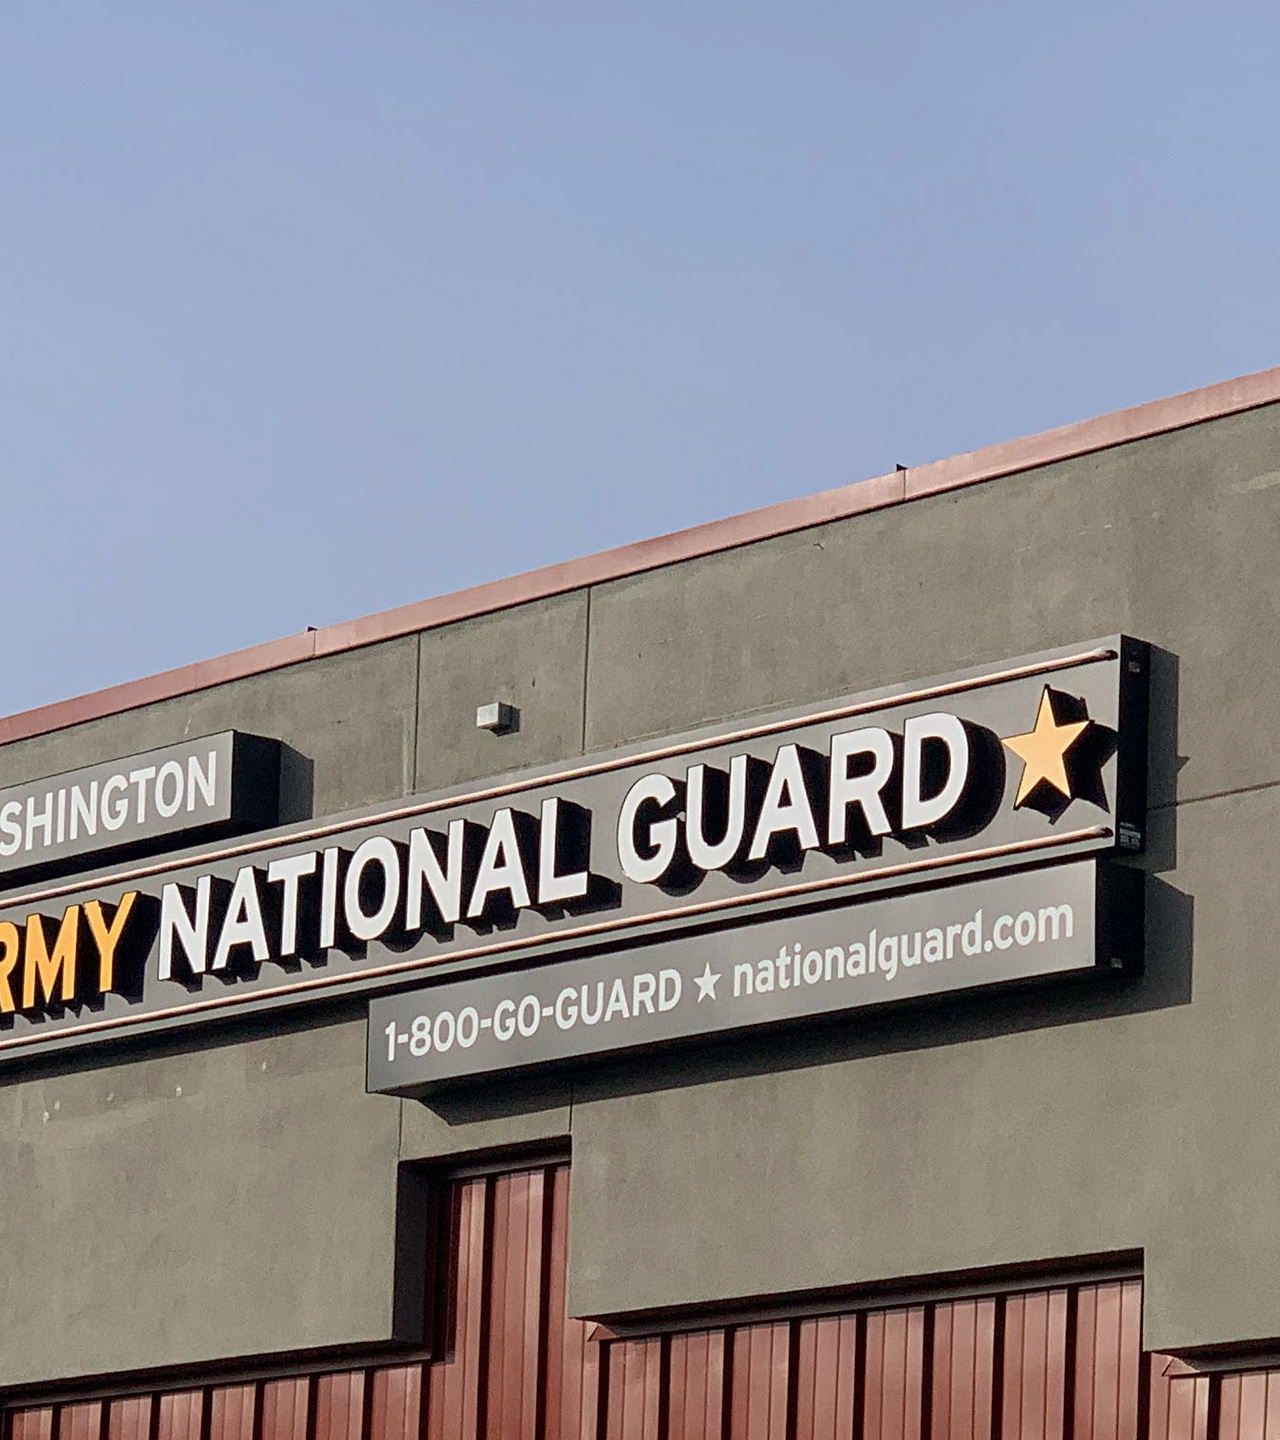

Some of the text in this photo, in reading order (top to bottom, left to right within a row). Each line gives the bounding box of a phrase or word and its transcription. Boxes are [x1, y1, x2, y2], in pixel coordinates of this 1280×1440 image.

[157, 796, 588, 981] NATIONAL
[617, 712, 970, 884] GUARD
[384, 902, 1074, 1062] 1-800-GO-GUARD nationalguard.com
